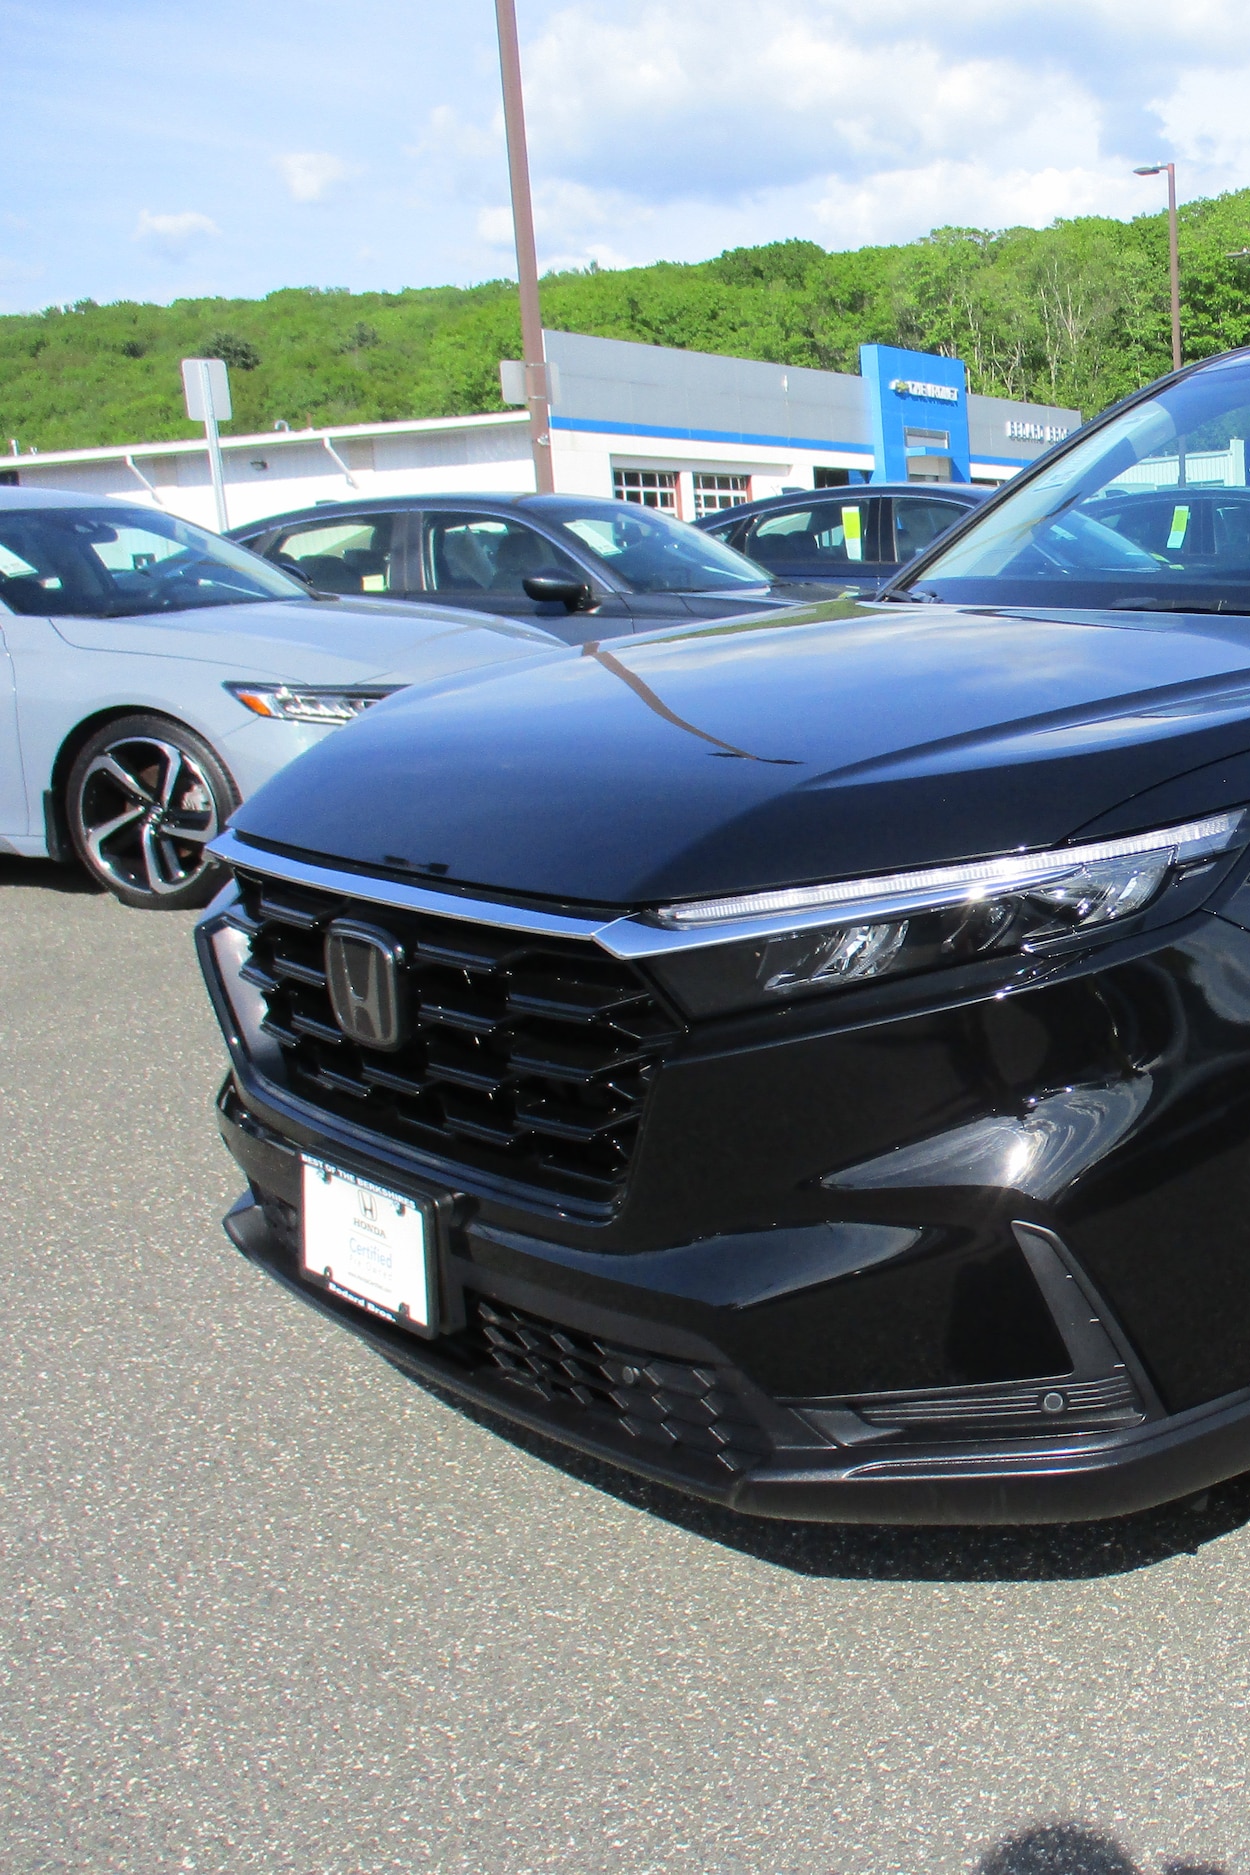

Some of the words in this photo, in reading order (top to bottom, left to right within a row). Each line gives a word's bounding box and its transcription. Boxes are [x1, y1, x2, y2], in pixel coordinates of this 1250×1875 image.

[301, 1153, 323, 1168] BEST
[325, 1164, 336, 1174] OF
[338, 1170, 355, 1183] THE
[356, 1178, 416, 1210] BERKSHIRES
[353, 1217, 386, 1238] HONDA
[349, 1238, 392, 1269] Certified
[328, 1282, 365, 1307] Bedard
